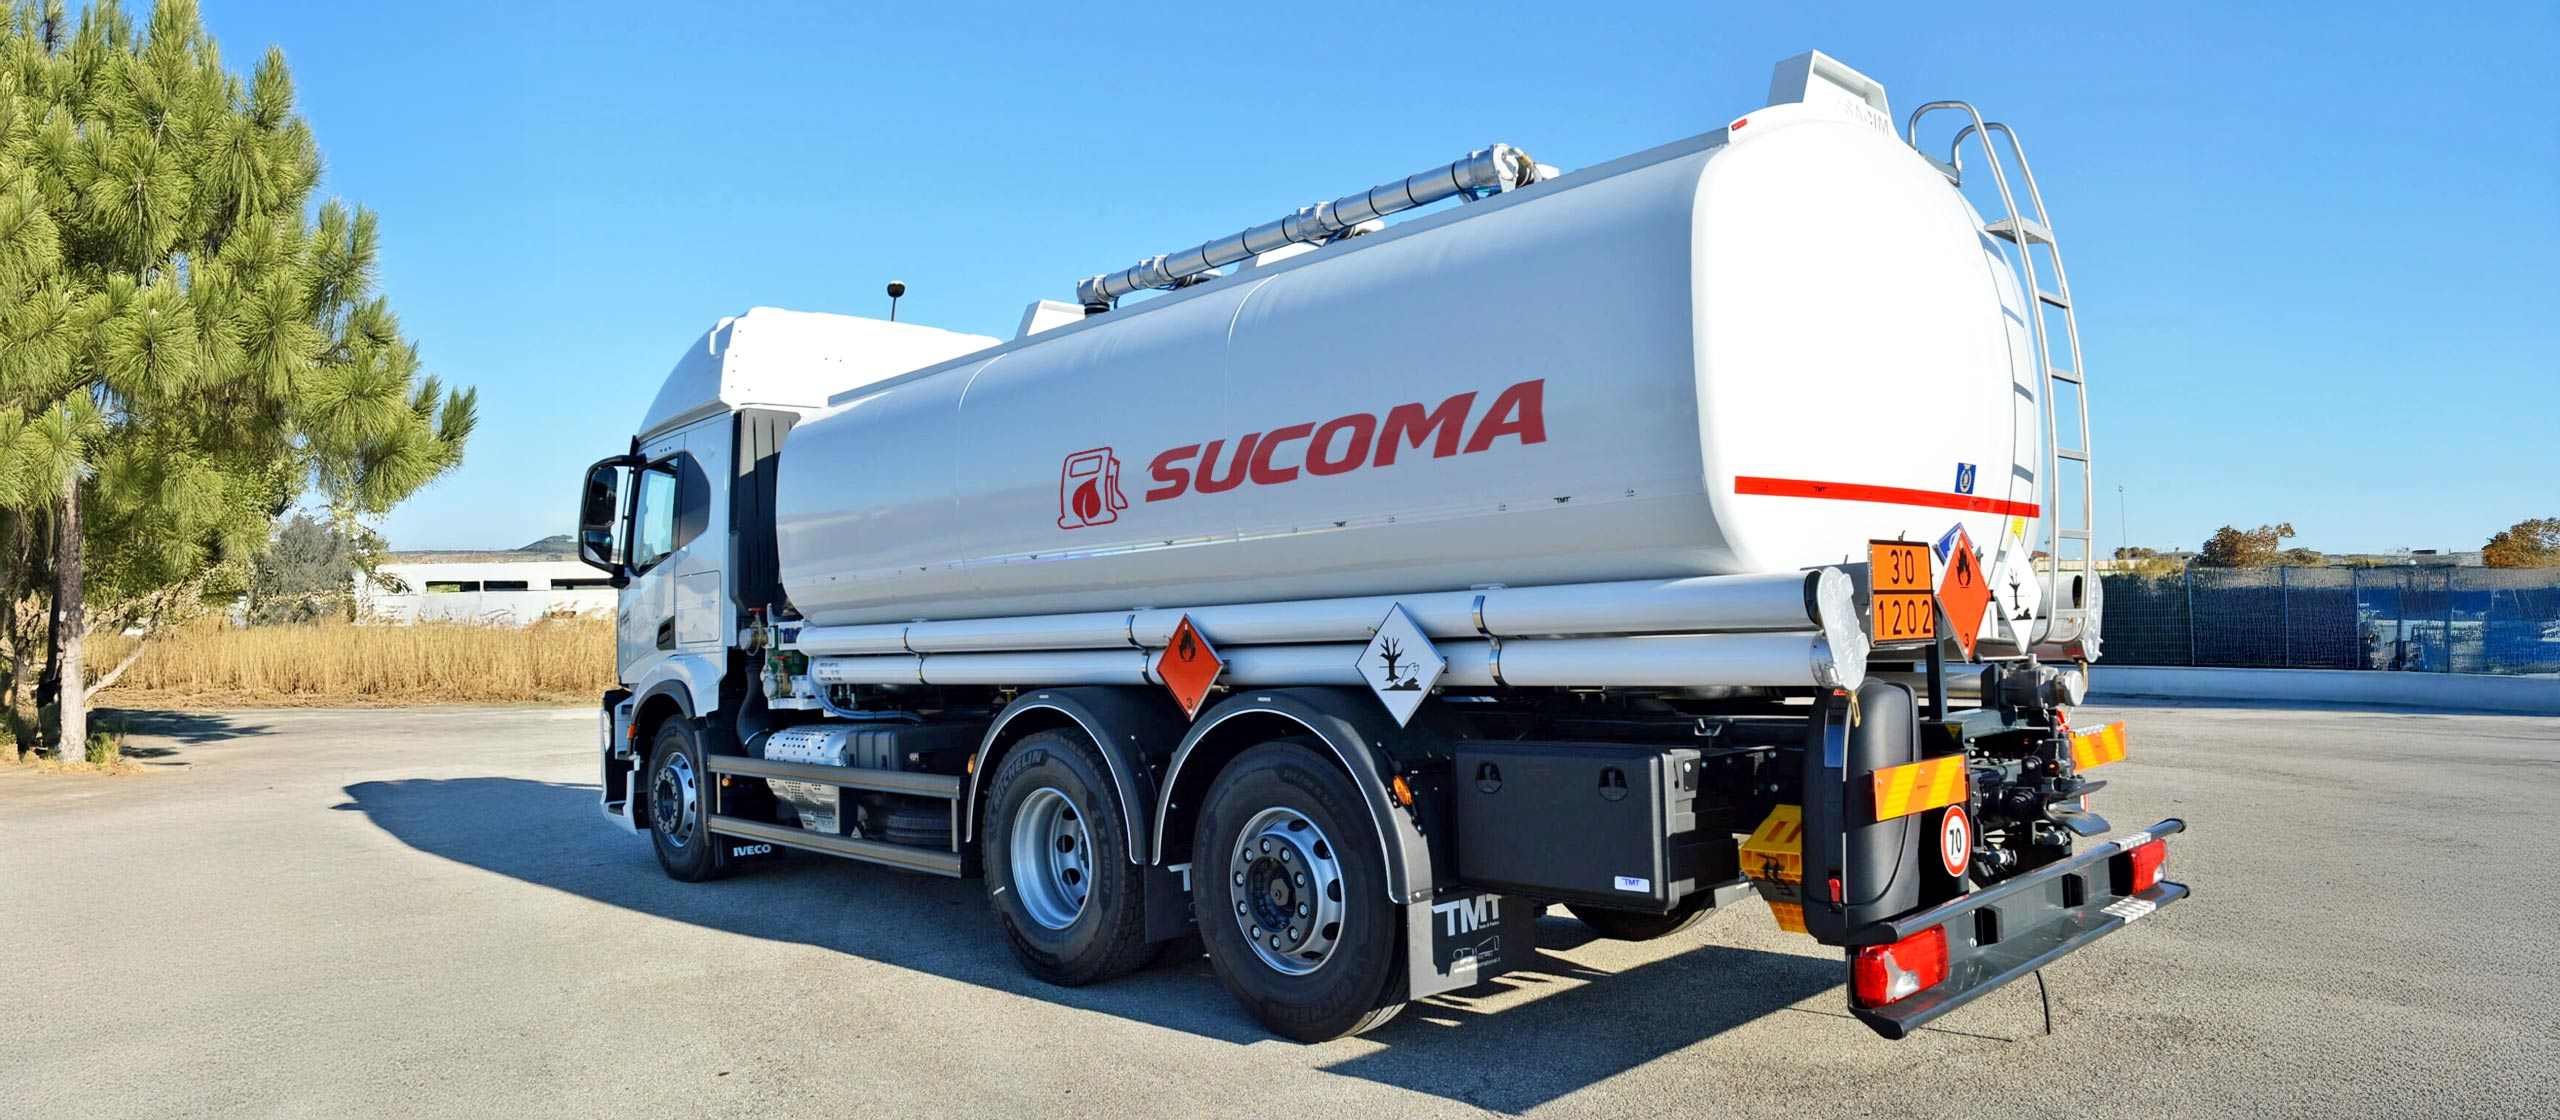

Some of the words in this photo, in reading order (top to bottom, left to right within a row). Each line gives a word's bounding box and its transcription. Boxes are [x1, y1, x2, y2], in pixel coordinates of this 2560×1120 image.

[1145, 378, 1547, 502] SUCOMA
[1890, 550, 1915, 585] 30
[1878, 600, 1932, 637] 1202
[1964, 632, 1970, 648] 3
[1186, 697, 1193, 710] 3
[733, 844, 771, 857] IVECO
[1949, 827, 1962, 856] 70
[1622, 878, 1640, 887] TMT
[1431, 893, 1502, 937] TMT
